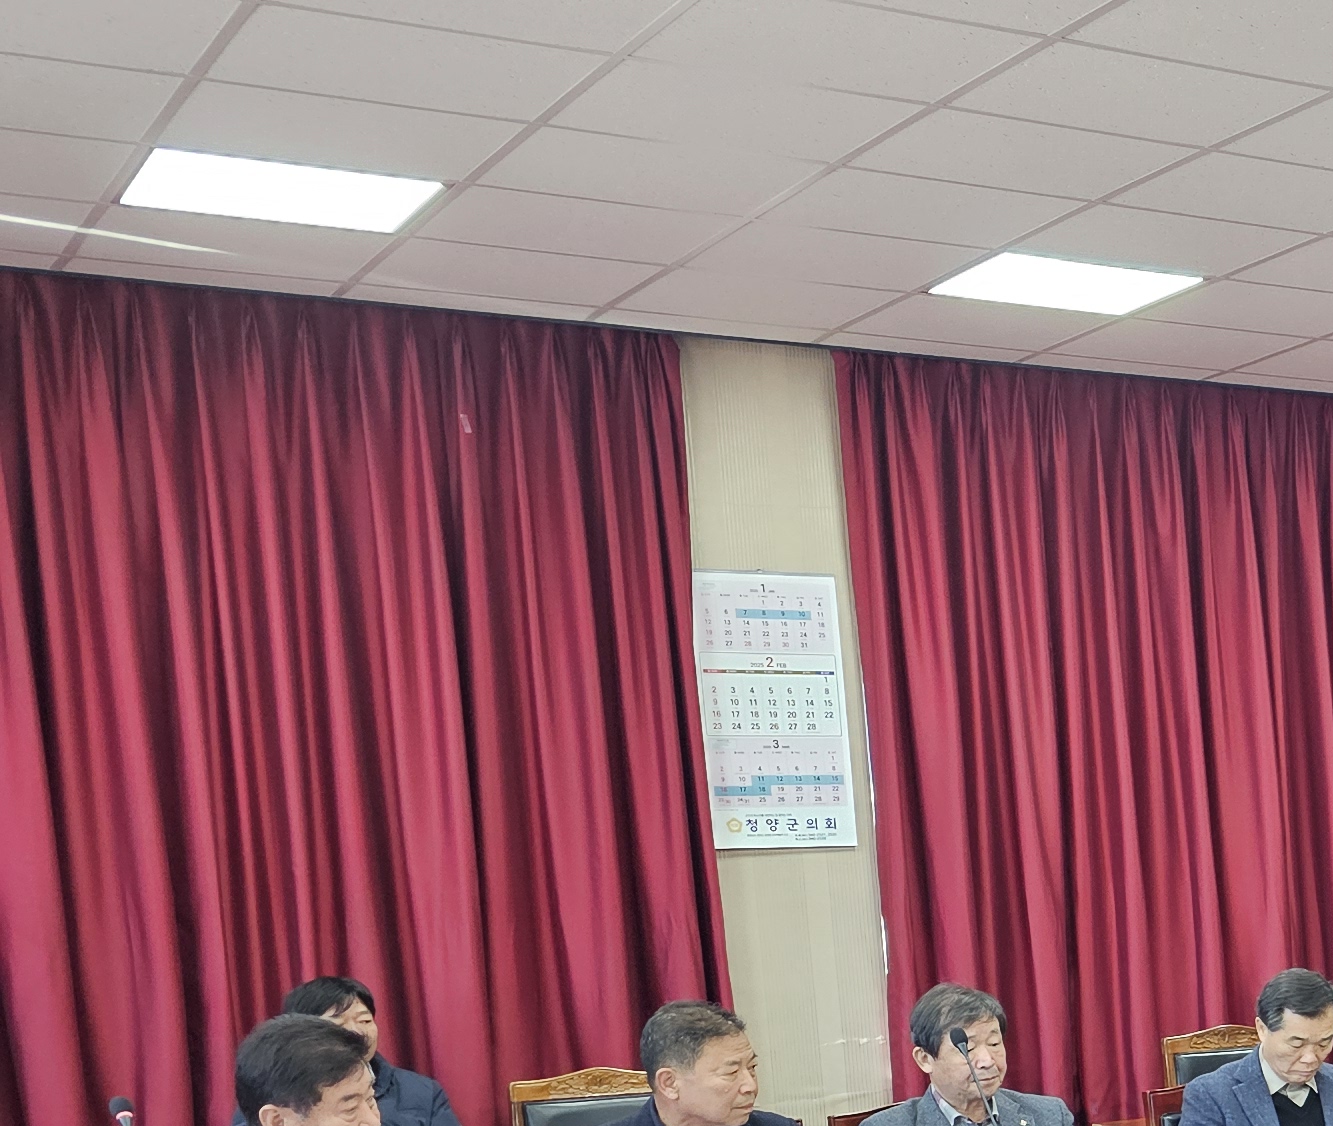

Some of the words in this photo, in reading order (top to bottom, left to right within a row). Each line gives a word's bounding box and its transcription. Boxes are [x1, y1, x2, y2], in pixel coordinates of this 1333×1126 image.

[760, 583, 766, 593] 1
[765, 656, 774, 668] 2
[730, 686, 736, 694] 3
[806, 687, 811, 695] 7
[730, 698, 739, 706] 10
[786, 699, 796, 707] 13
[787, 711, 797, 719] 20
[806, 711, 815, 719] 21
[772, 739, 780, 749] 3
